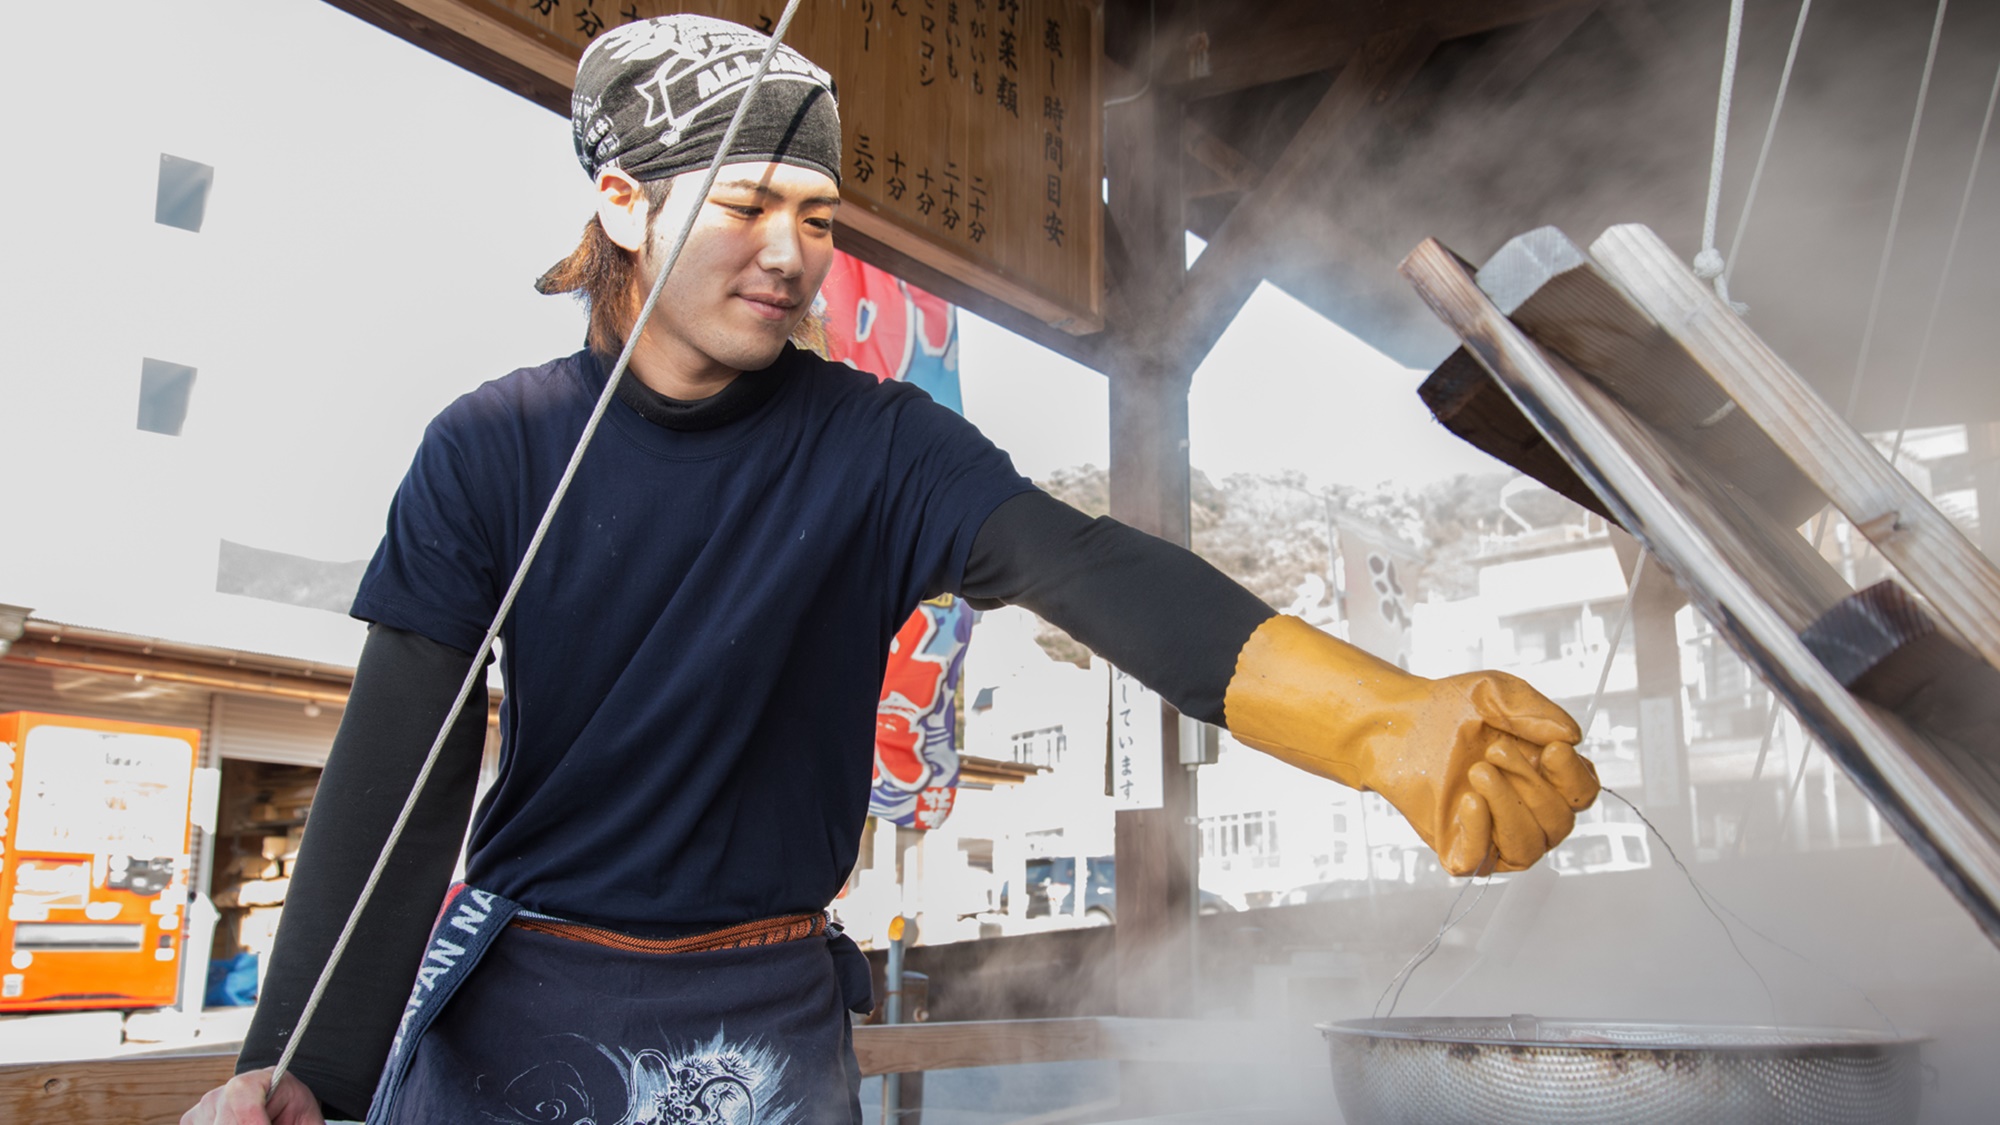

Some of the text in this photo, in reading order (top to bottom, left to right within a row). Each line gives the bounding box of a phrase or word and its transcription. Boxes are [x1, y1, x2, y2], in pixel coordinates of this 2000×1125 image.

[853, 133, 875, 184] 三分
[1043, 17, 1065, 248] 蒸し時間目安
[886, 151, 907, 201] 十分
[916, 167, 936, 216] 十分
[941, 162, 961, 231] 二十分
[967, 176, 987, 244] 二十分
